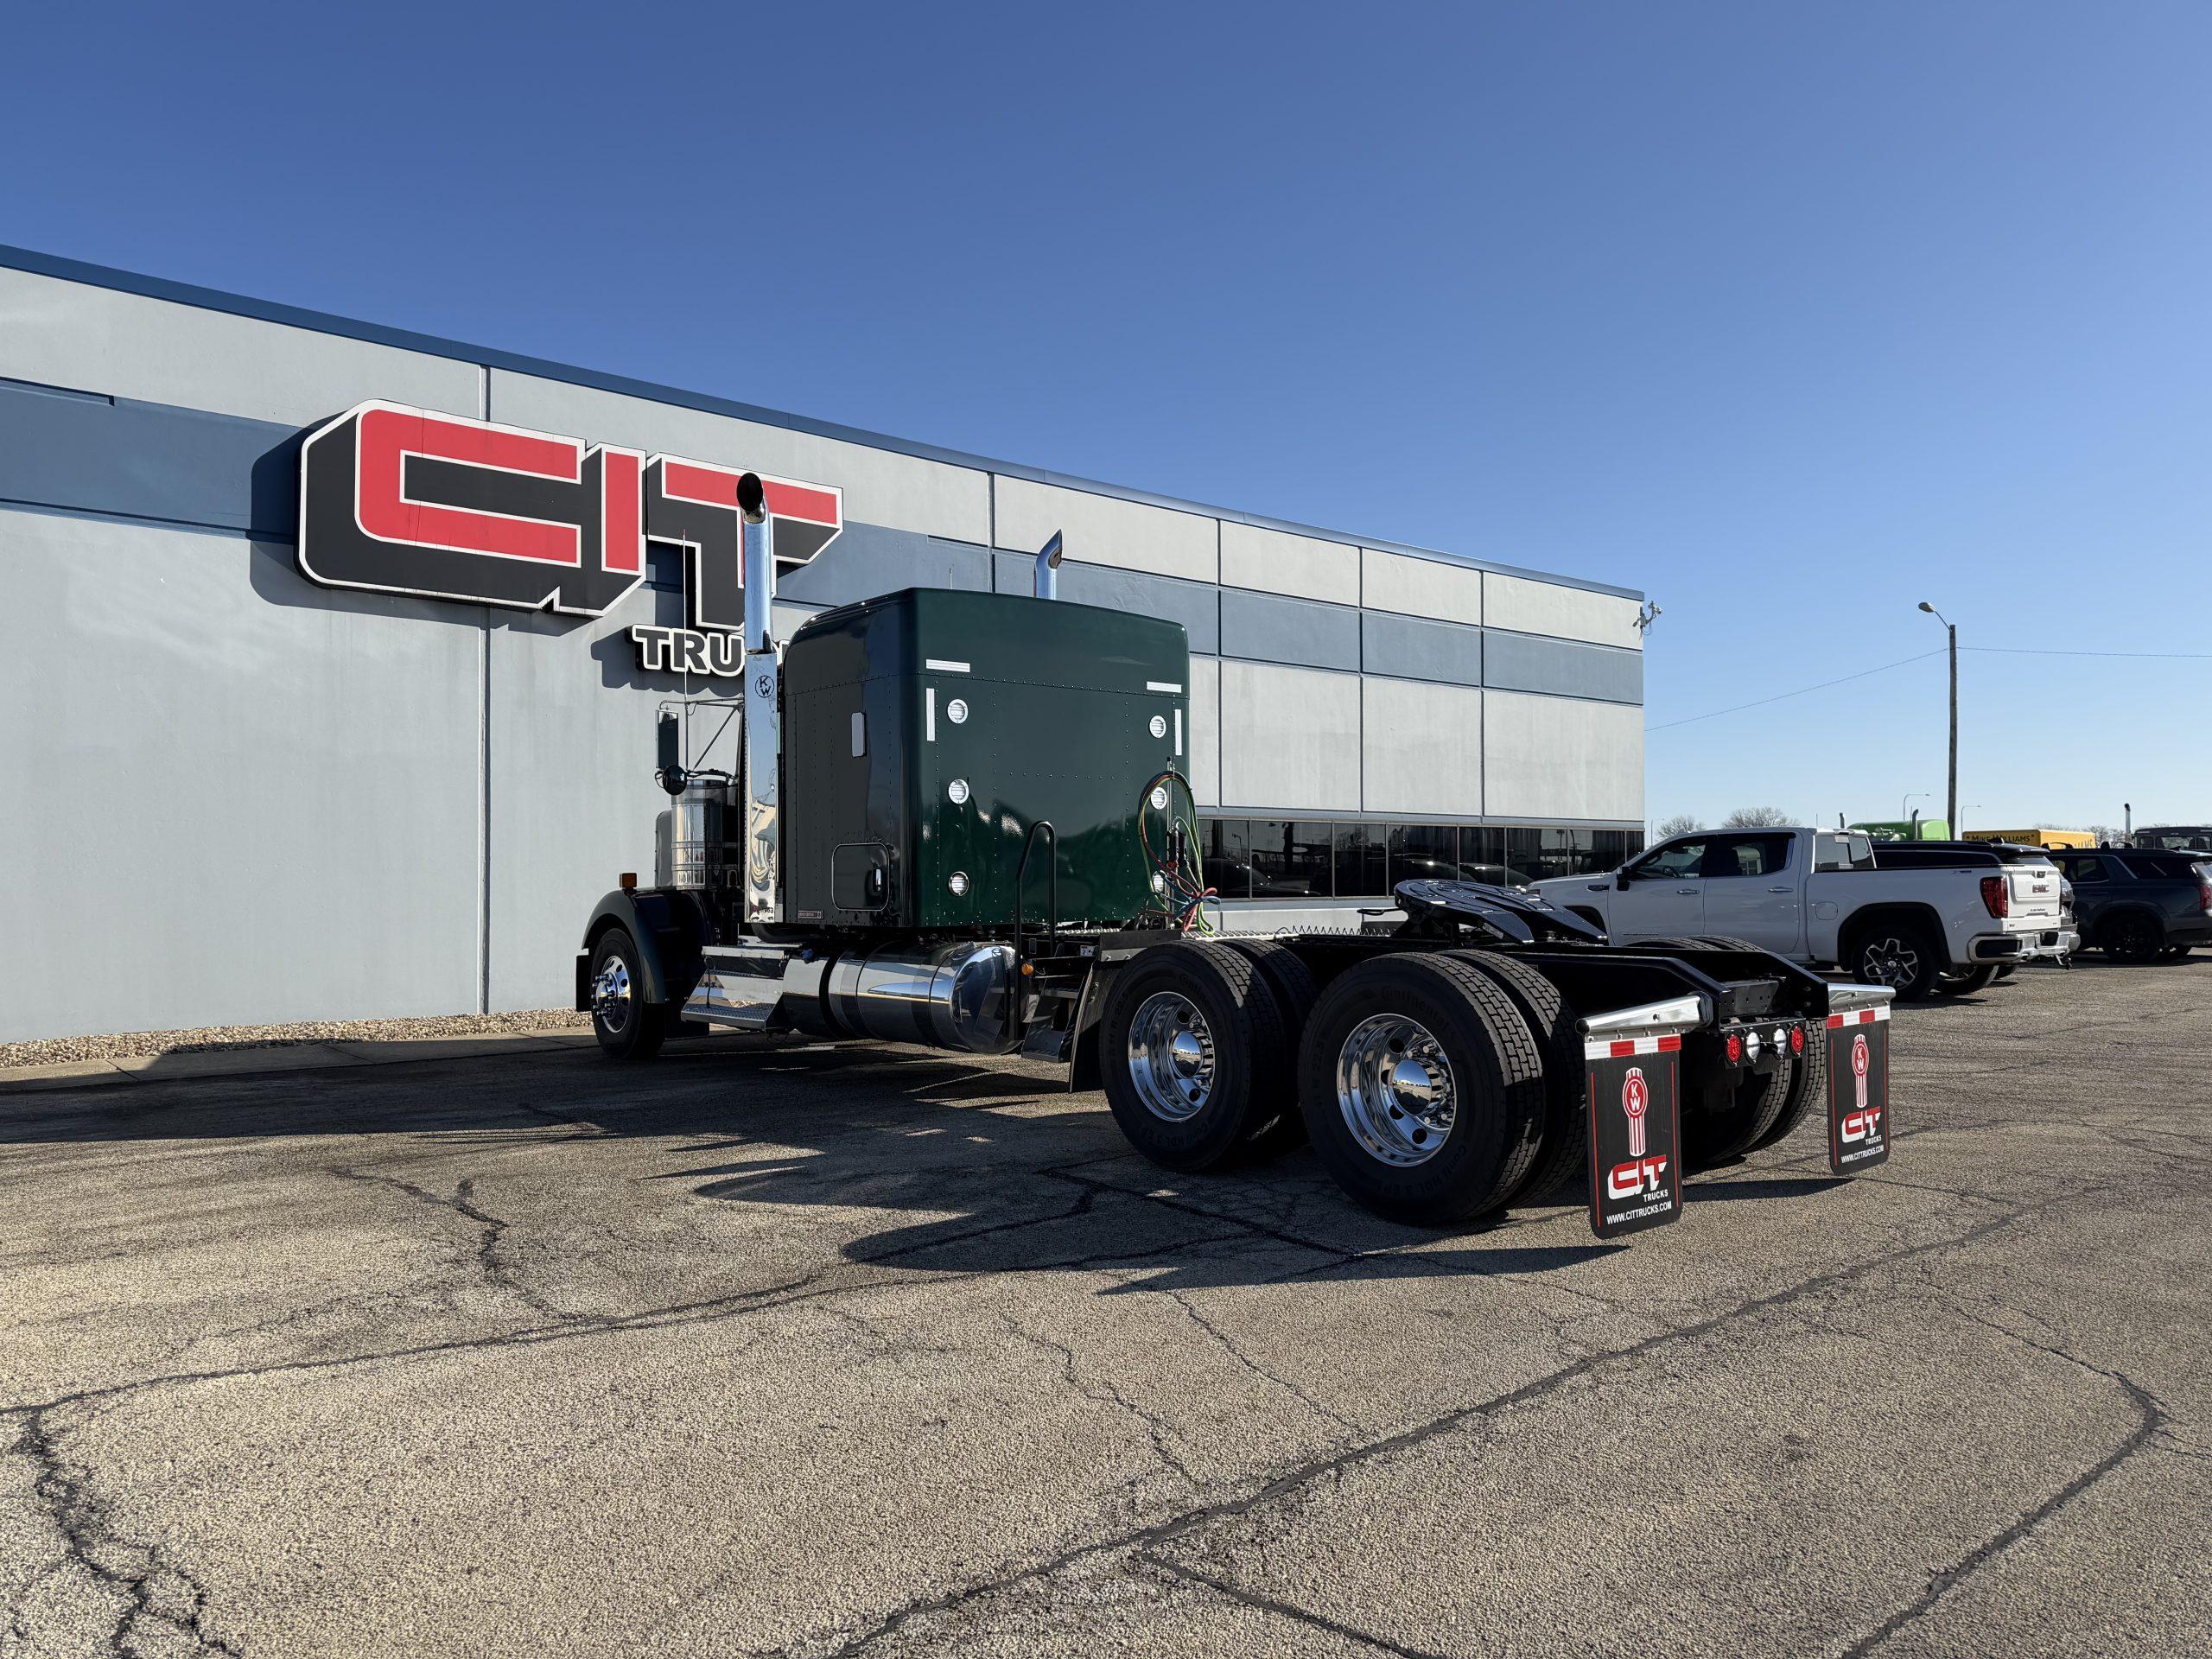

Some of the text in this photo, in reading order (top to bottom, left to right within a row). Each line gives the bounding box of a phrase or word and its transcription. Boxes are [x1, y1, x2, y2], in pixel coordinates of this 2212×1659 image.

[299, 398, 843, 631] CIT
[1381, 986, 1450, 1031] Continental
[1841, 1106, 1881, 1143] CIT
[1865, 1135, 1882, 1145] TRUCKS
[1840, 1144, 1885, 1164] WWW.CITTRUCKS.COM
[1607, 1154, 1668, 1200] CIT
[1643, 1189, 1669, 1202] TRUCKS
[1606, 1200, 1672, 1225] WWW.CITTRUCKS.COM
